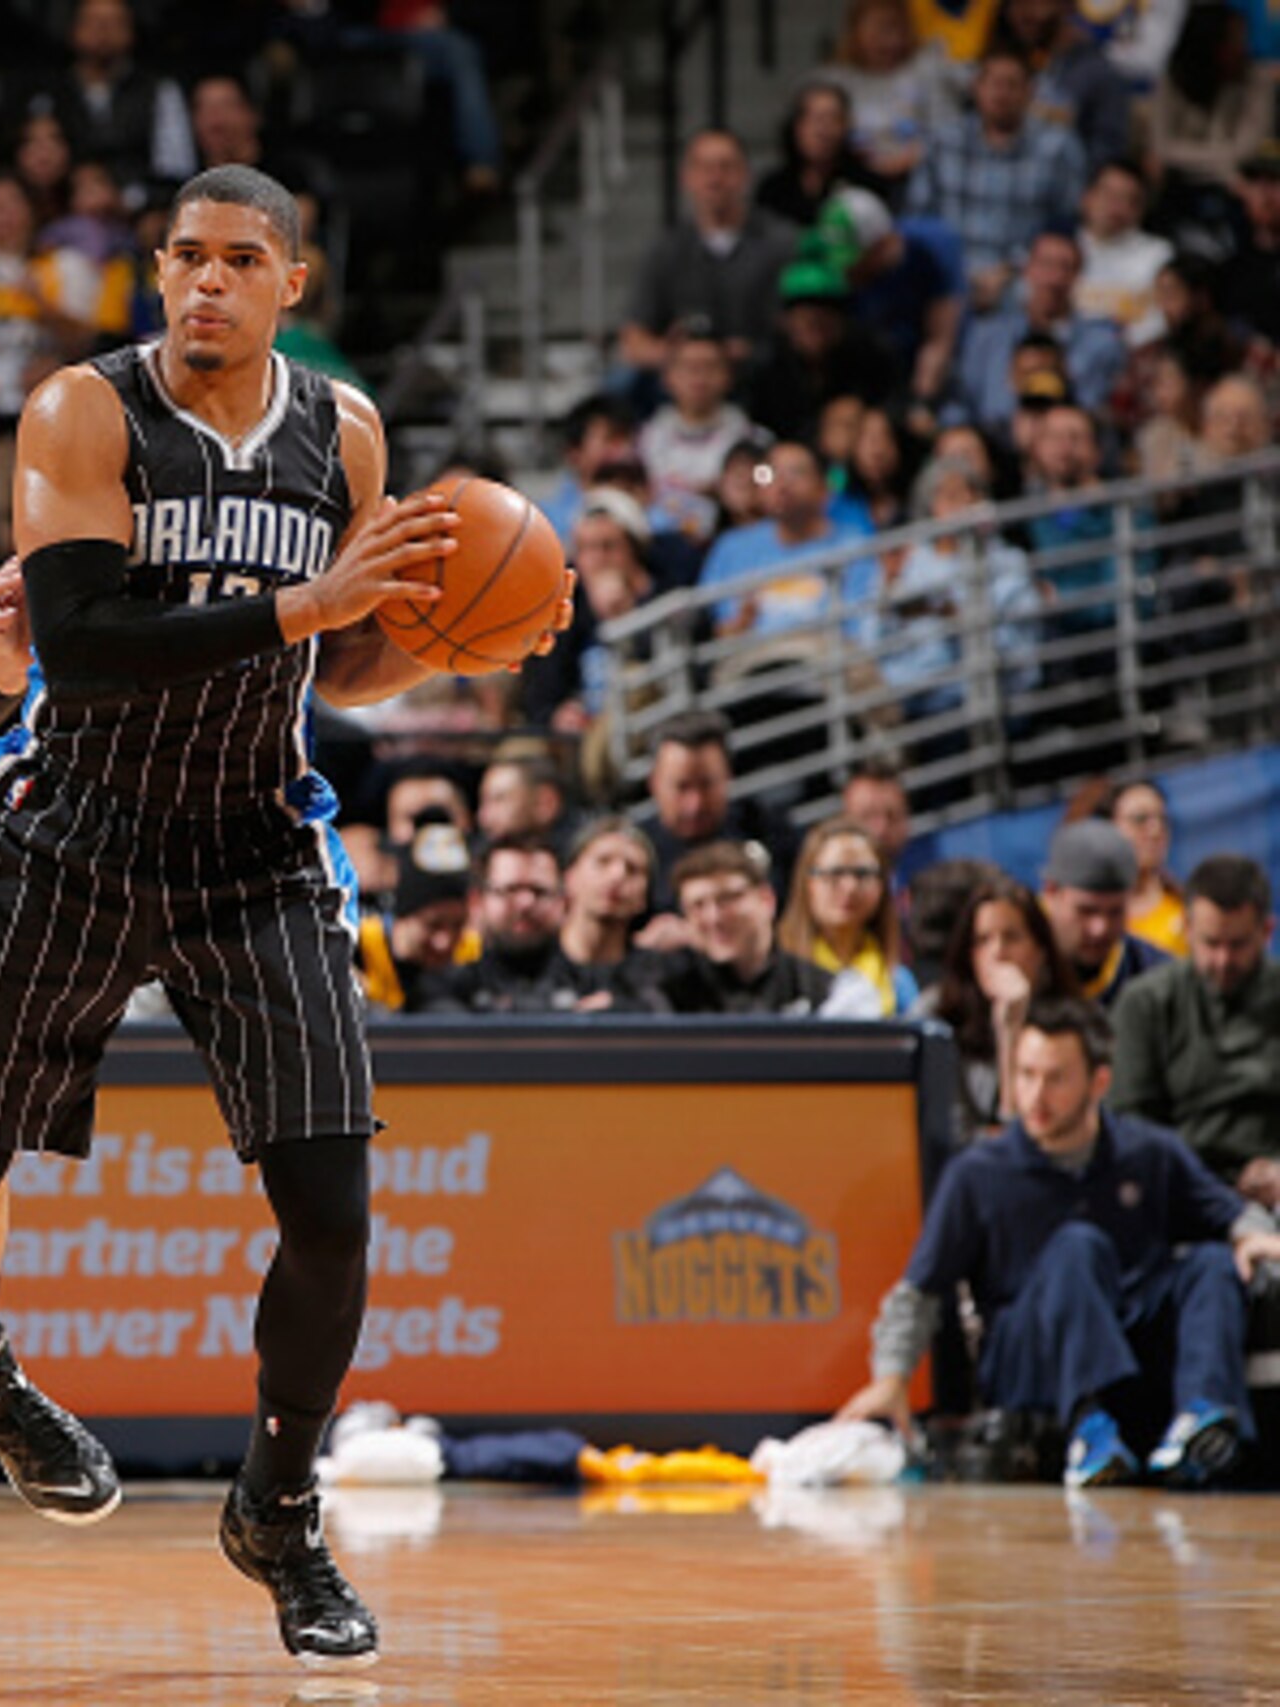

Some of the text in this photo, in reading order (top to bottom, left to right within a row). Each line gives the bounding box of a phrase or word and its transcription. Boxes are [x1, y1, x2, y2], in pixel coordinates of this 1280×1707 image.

[9, 1136, 121, 1196] &T
[127, 1132, 191, 1196] is
[2, 1213, 454, 1277] artner o he
[614, 1229, 839, 1323] NUGGETS
[198, 1295, 501, 1369] Ngets
